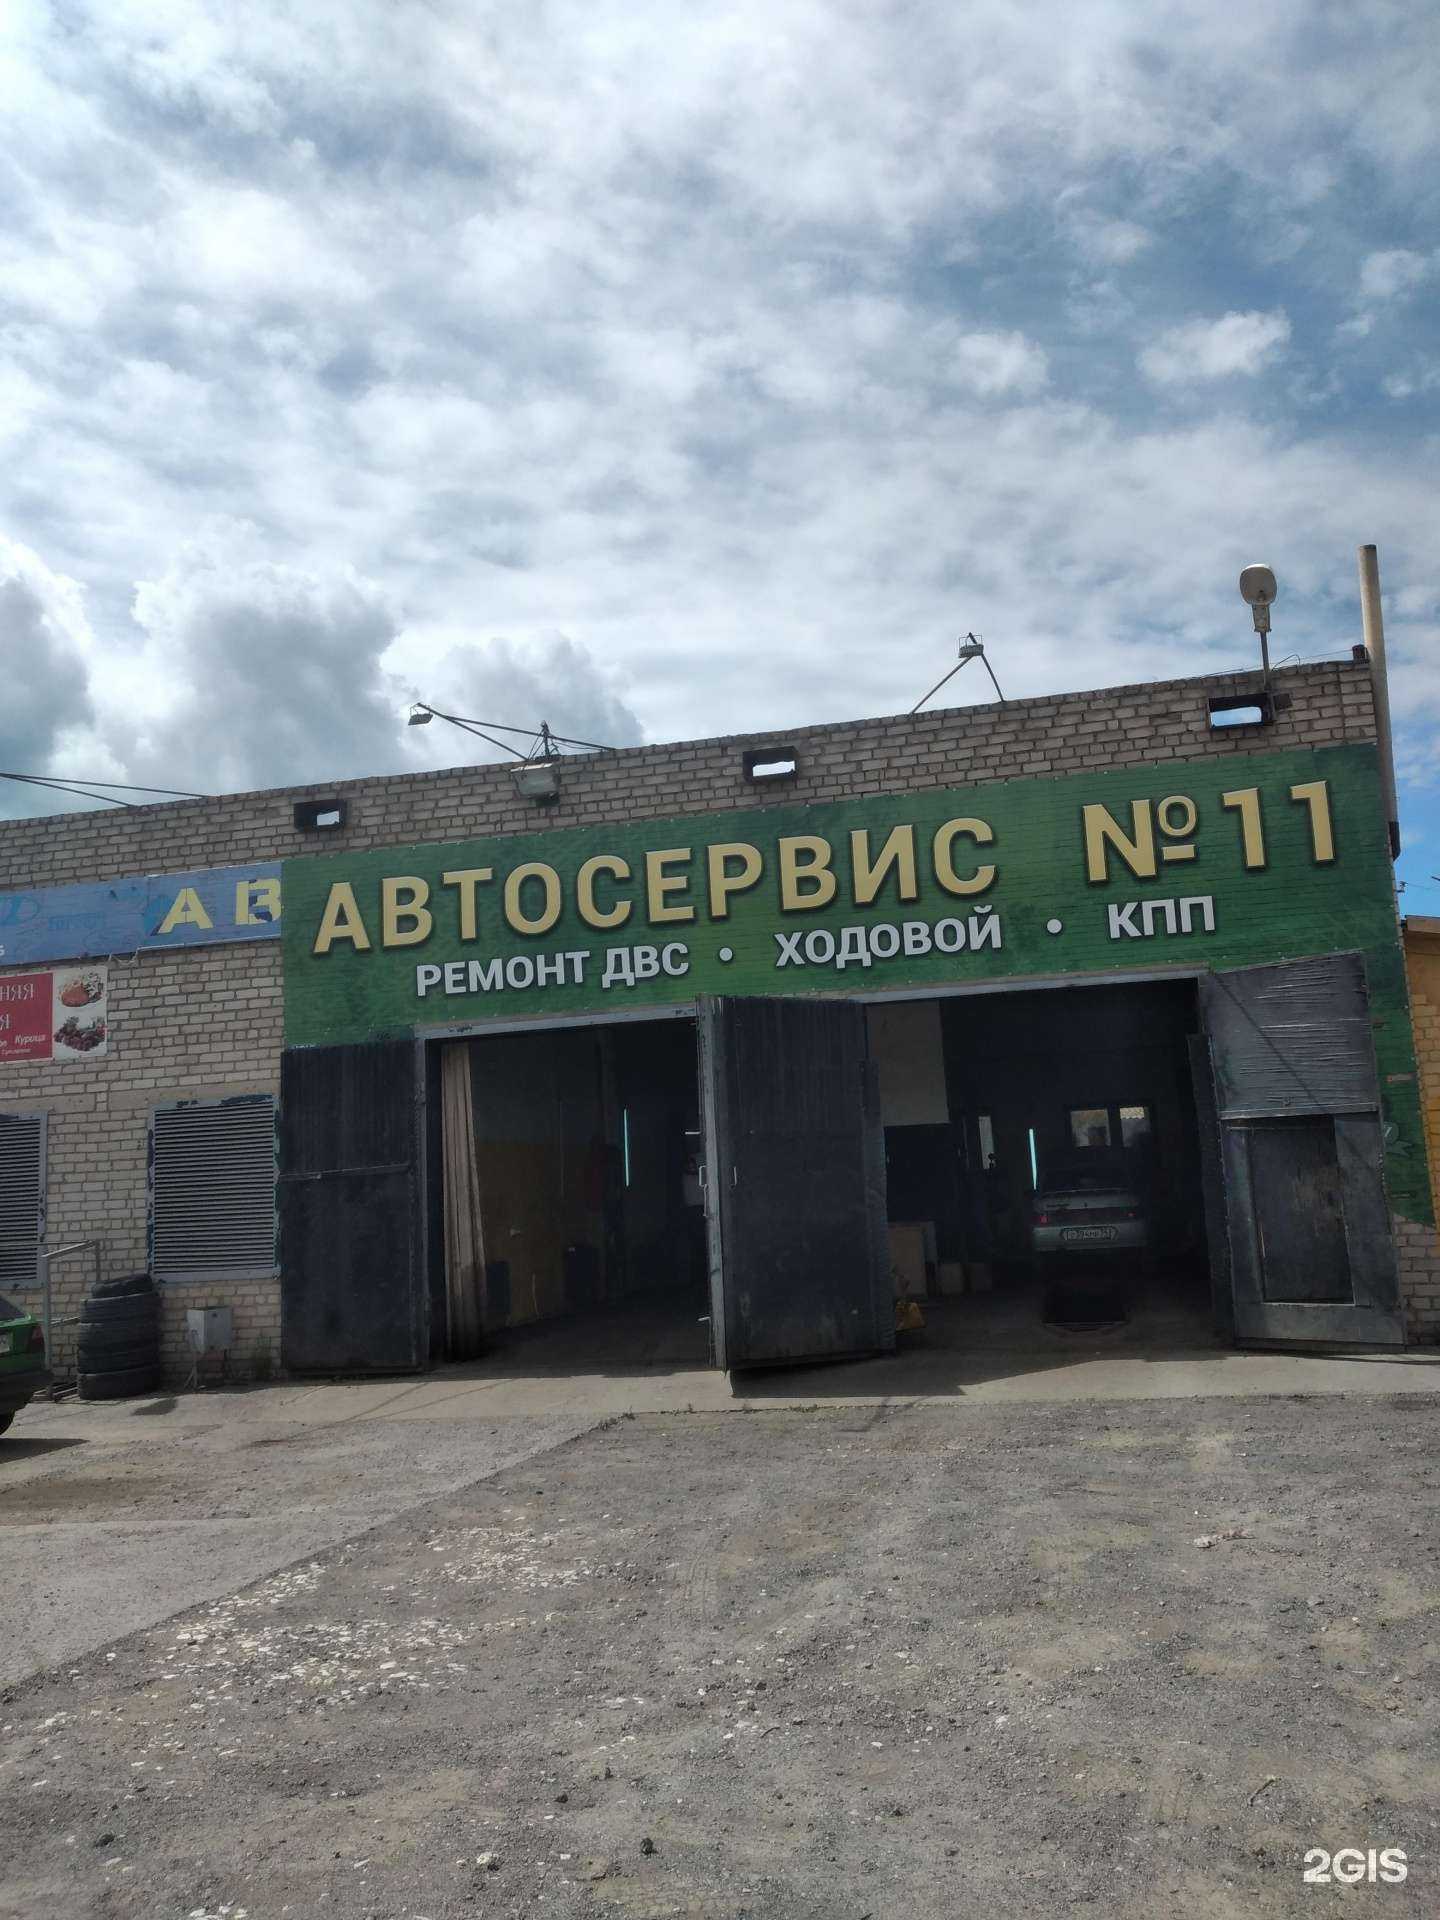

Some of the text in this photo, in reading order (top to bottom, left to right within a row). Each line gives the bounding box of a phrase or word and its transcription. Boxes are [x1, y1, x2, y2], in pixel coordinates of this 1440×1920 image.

[313, 817, 997, 954] АВТОСЕРВИС
[416, 896, 1215, 997] РЕМОНТ ДВС ХОДОВОЙ КПП
